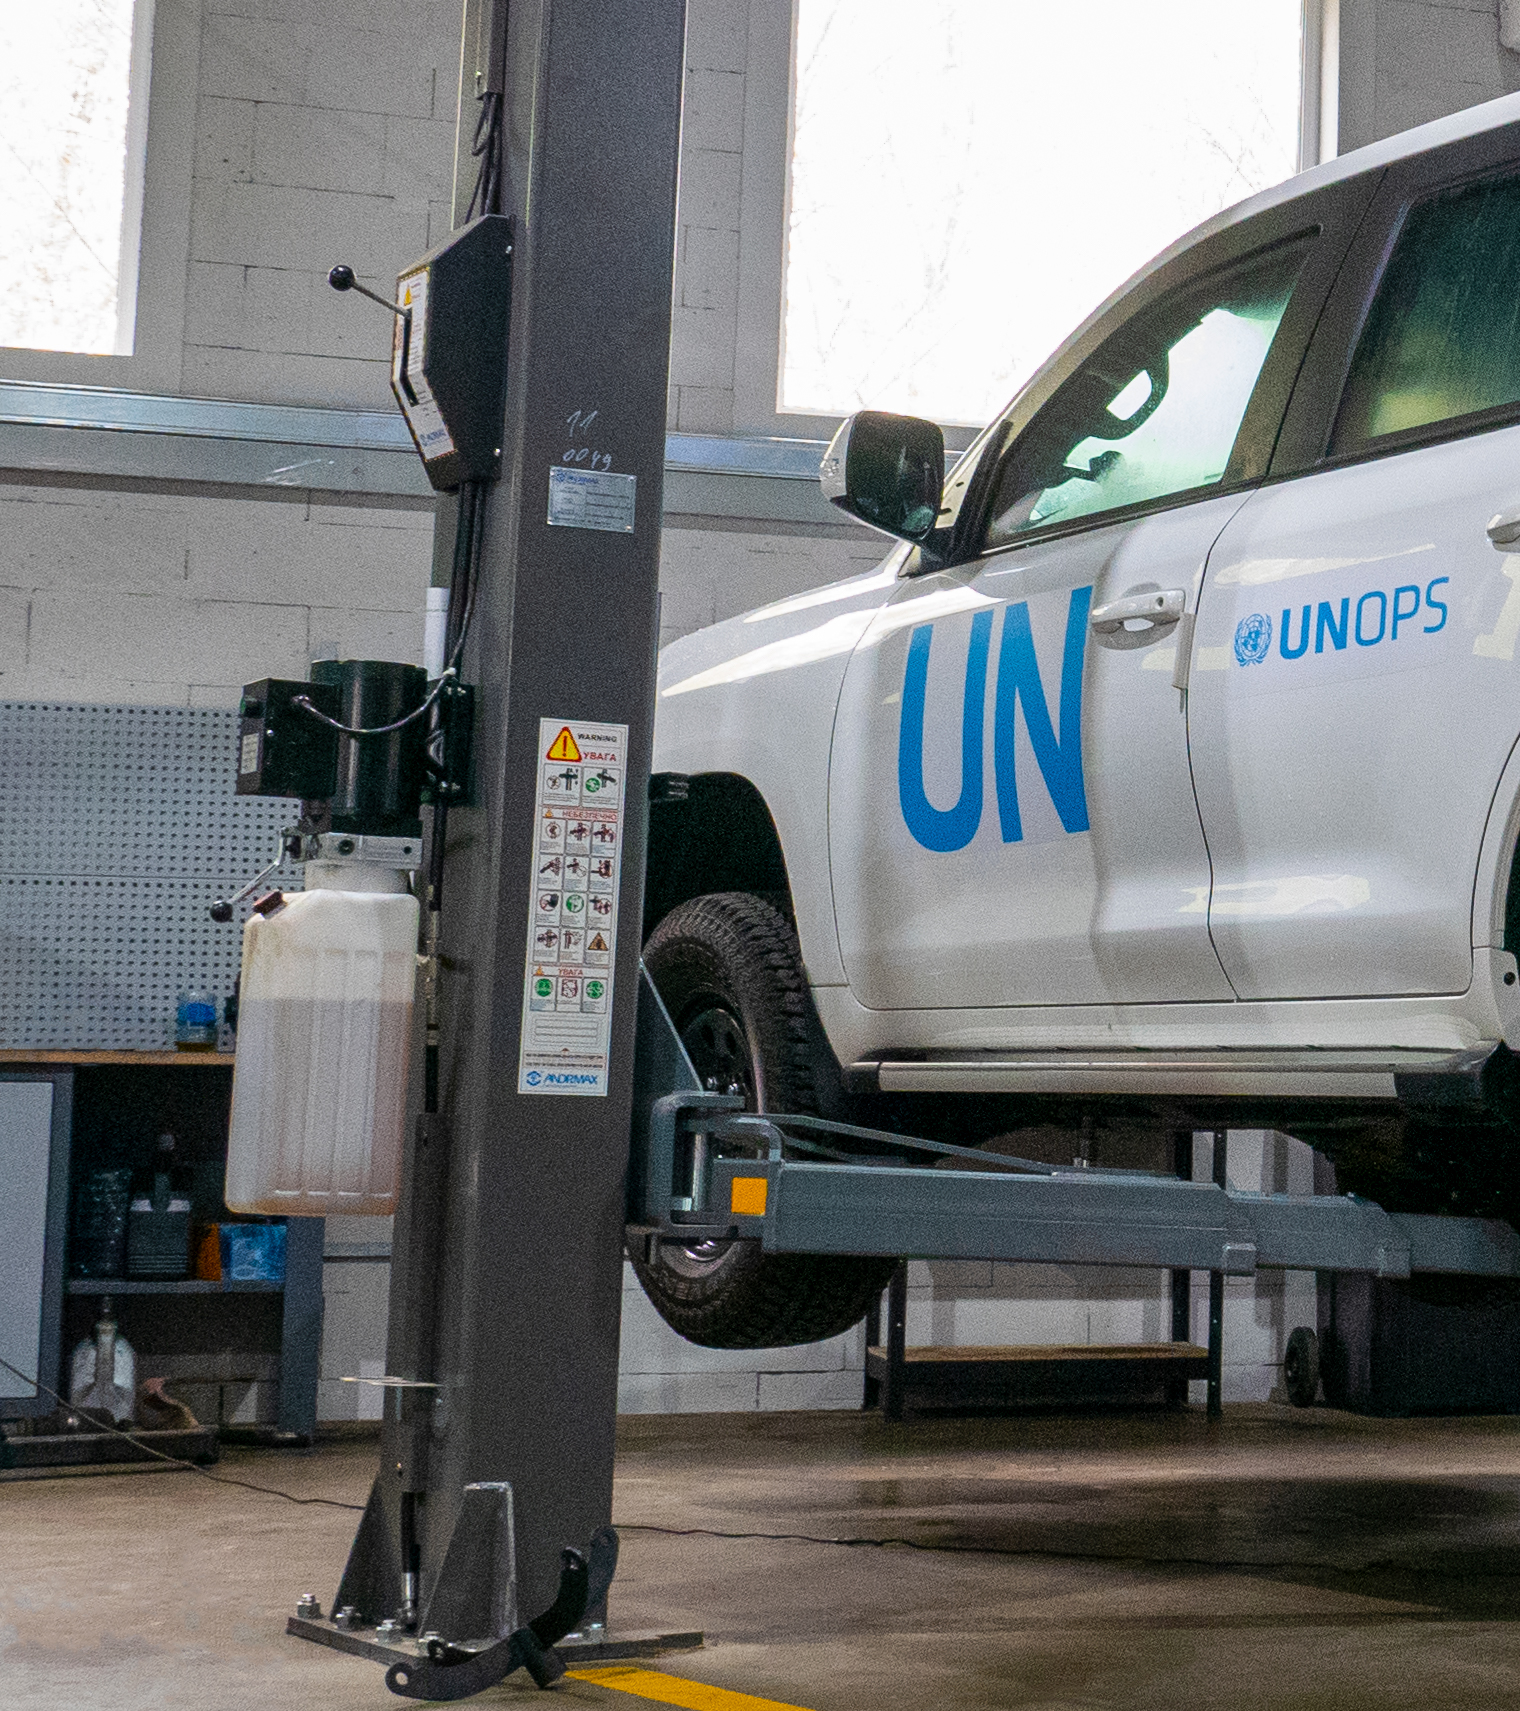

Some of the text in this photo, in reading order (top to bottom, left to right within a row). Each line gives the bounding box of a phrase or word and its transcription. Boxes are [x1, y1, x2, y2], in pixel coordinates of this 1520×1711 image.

[1279, 577, 1450, 659] UNOPS
[577, 733, 618, 743] WARNING
[898, 585, 1093, 853] UN
[583, 752, 617, 762] УВАГА
